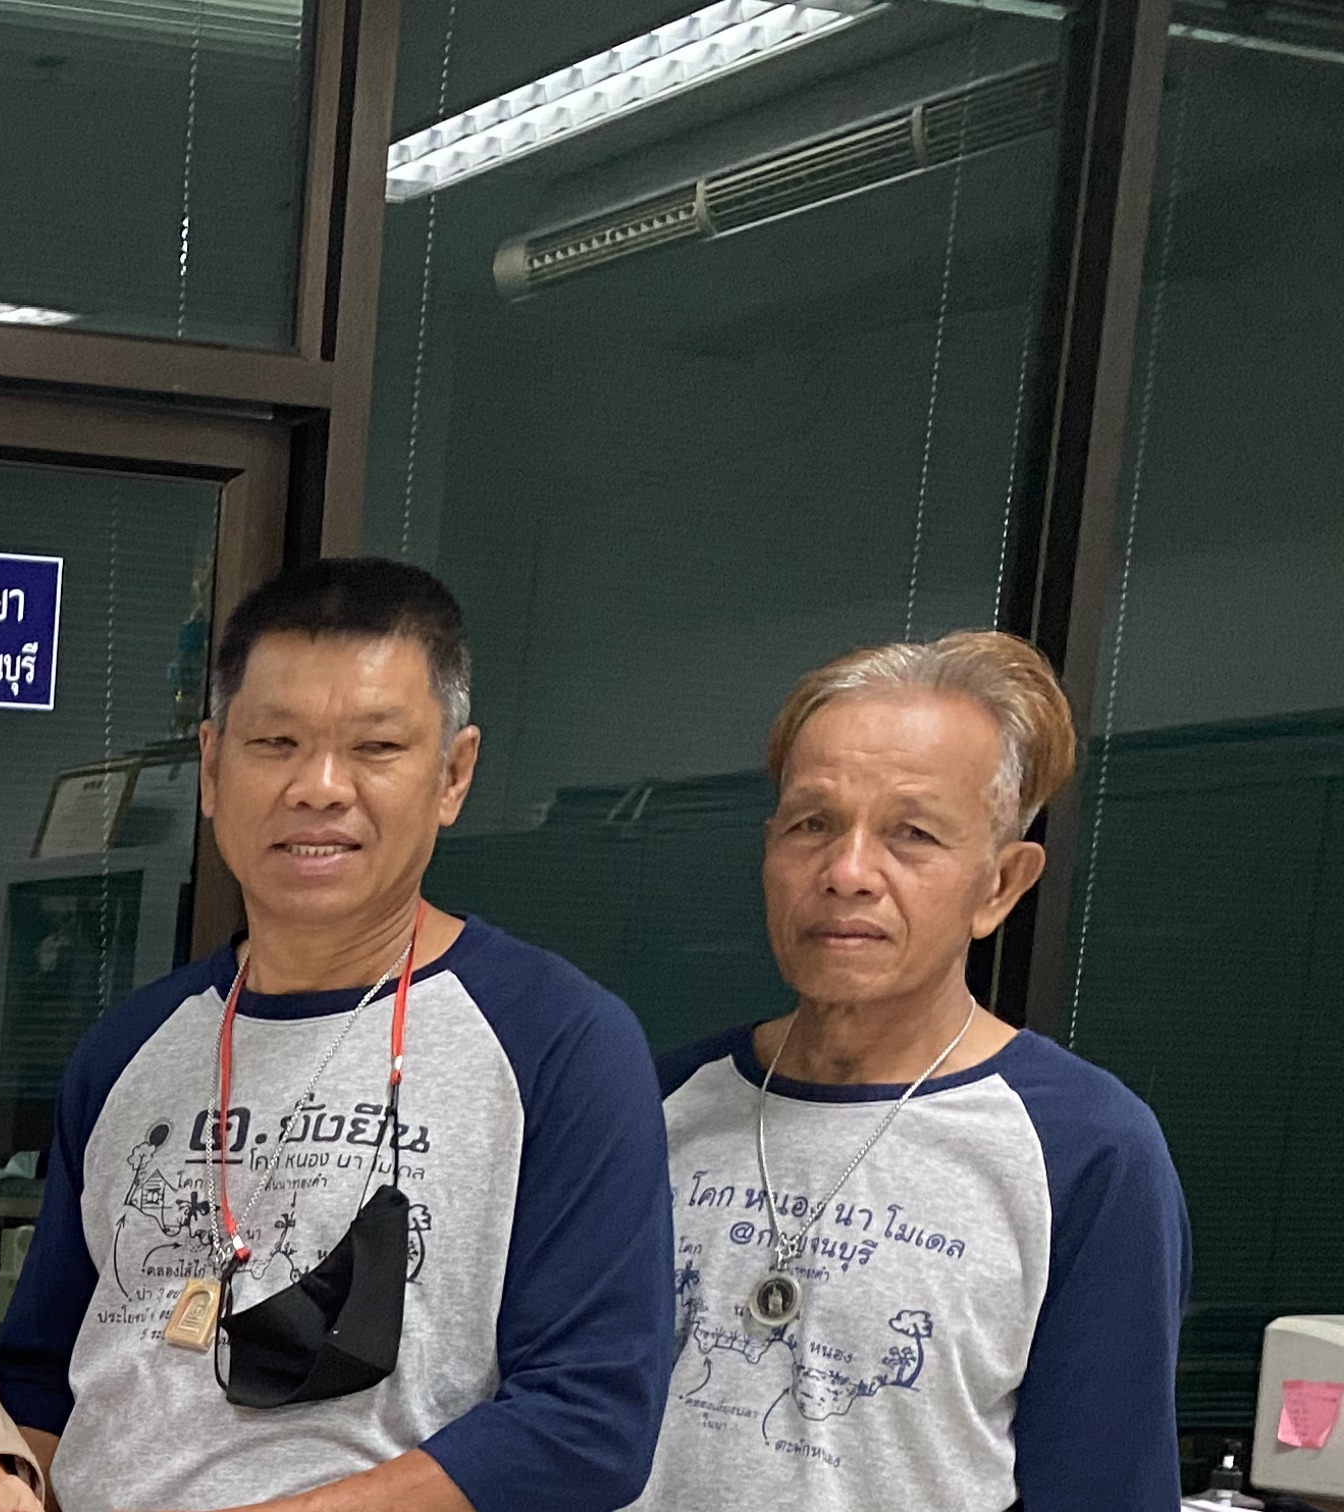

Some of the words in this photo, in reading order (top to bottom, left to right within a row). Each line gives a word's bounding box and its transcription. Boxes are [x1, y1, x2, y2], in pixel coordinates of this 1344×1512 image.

[285, 1151, 330, 1169] หนอง
[337, 1153, 363, 1171] นา
[177, 1172, 204, 1190] โคก
[687, 1171, 735, 1207] โคก
[835, 1202, 874, 1231] นา
[884, 1203, 967, 1259] โมเดล
[245, 1229, 262, 1242] นา
[810, 1340, 854, 1364] หนอง
